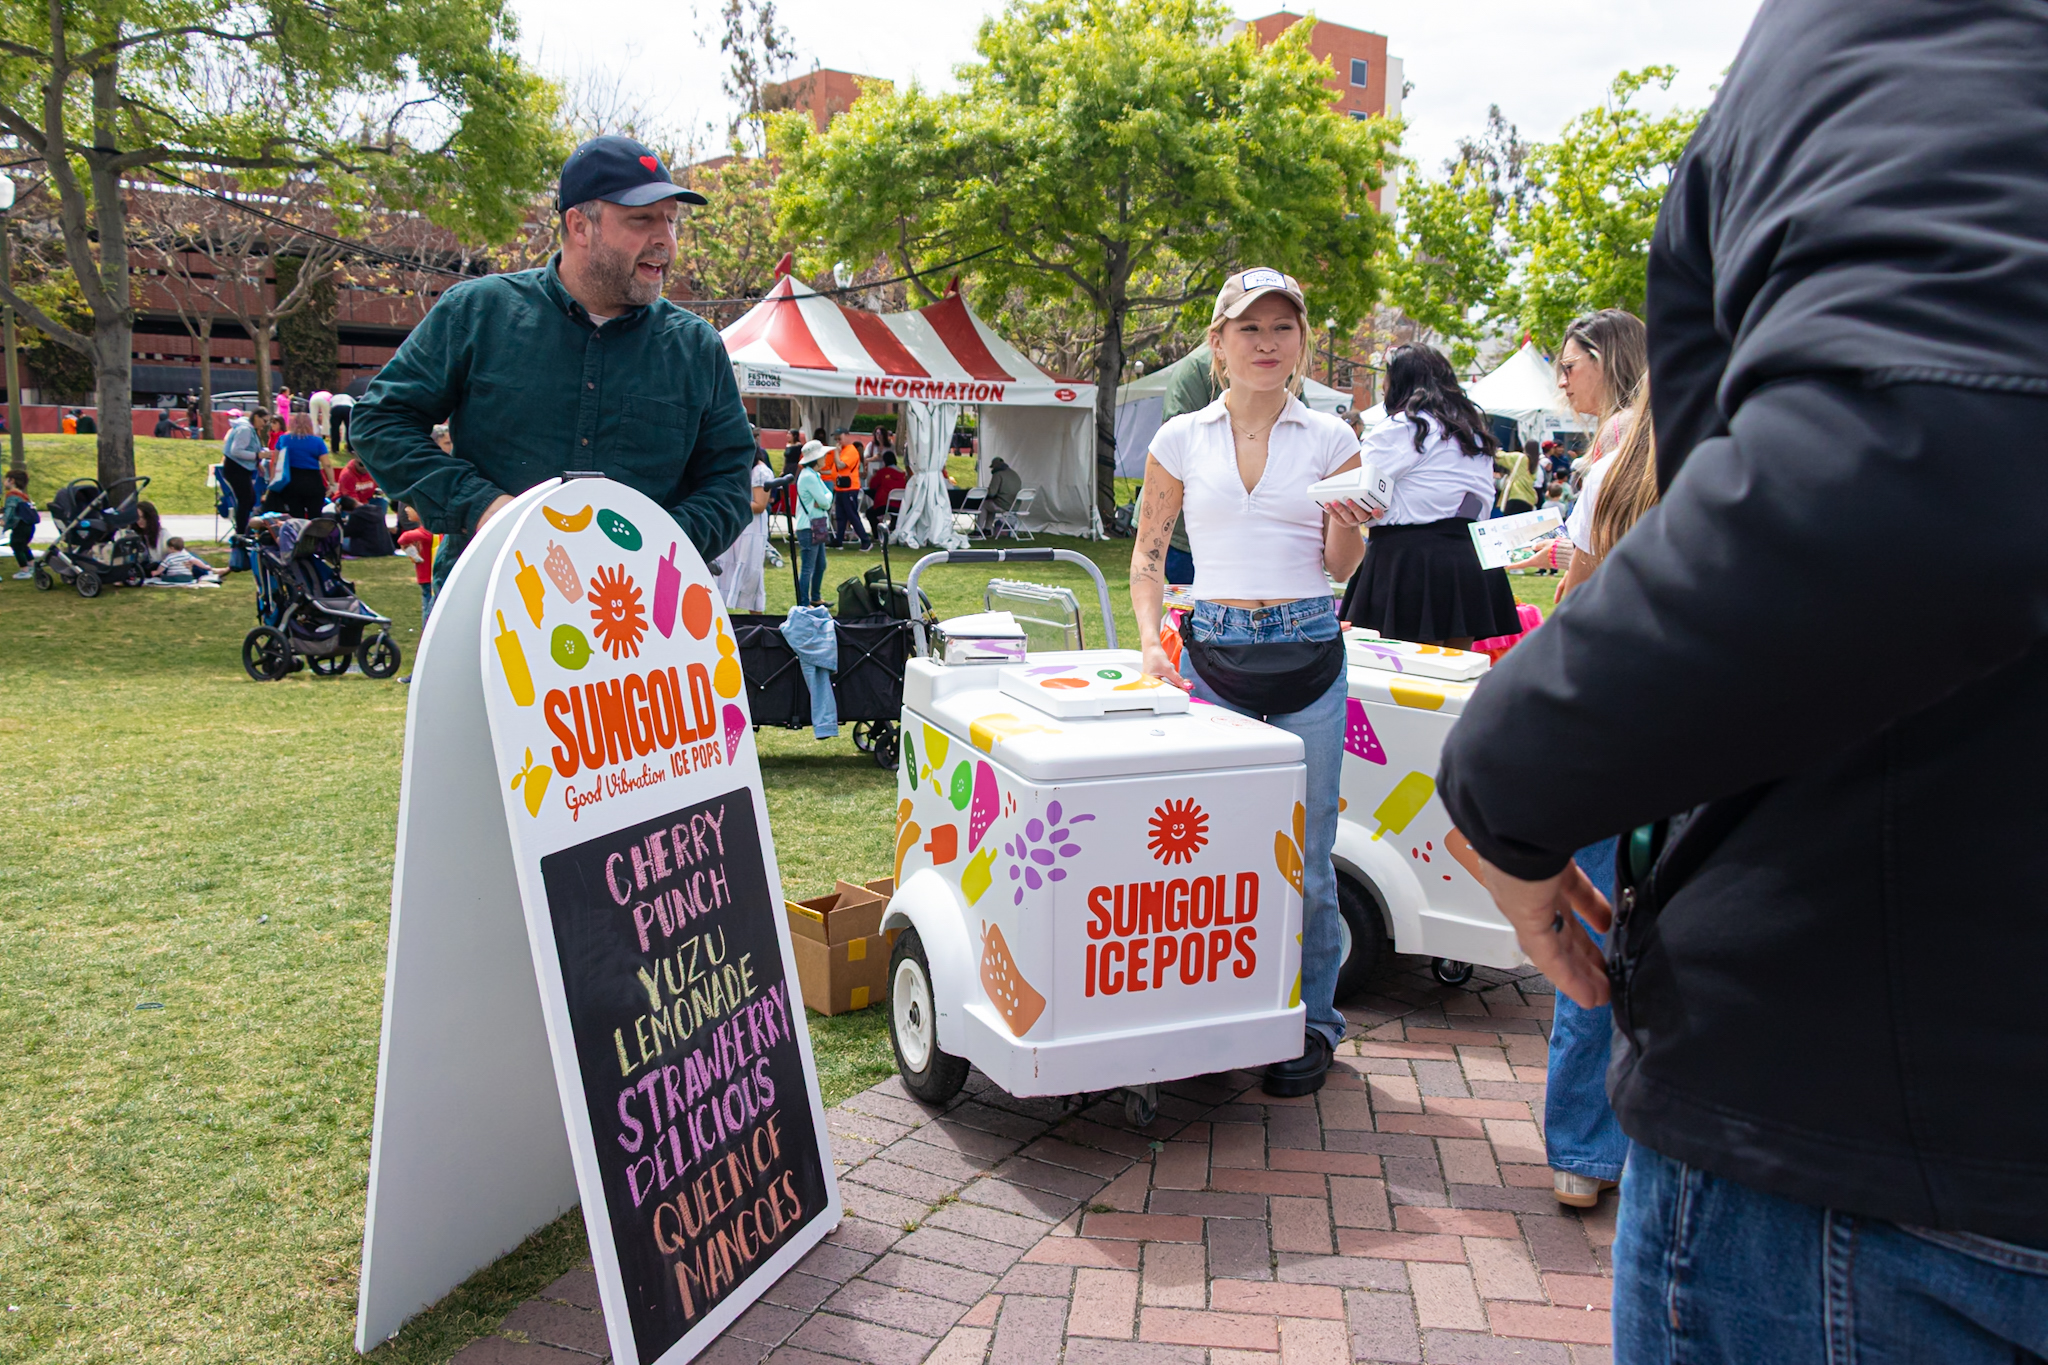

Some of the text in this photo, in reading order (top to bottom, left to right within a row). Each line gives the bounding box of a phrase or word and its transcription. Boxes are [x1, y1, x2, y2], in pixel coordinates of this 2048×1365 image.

[747, 372, 782, 381] FESTIVAL
[755, 380, 781, 388] BOOKS
[854, 376, 1006, 403] INFORMATION
[544, 663, 716, 778] SUNGOLD
[564, 740, 723, 823] Good Vibration ICE POPS
[605, 804, 726, 906] CHERRY
[632, 863, 731, 953] PUNCH
[1087, 872, 1259, 939] SUNGOLD
[613, 952, 758, 1077] LEMONADE
[636, 924, 727, 1012] YUZU
[617, 979, 791, 1153] STRAWBERRY
[625, 1056, 776, 1208] DELICIOUS
[652, 1109, 781, 1255] QUEEN OF
[674, 1169, 803, 1320] MANGOES
